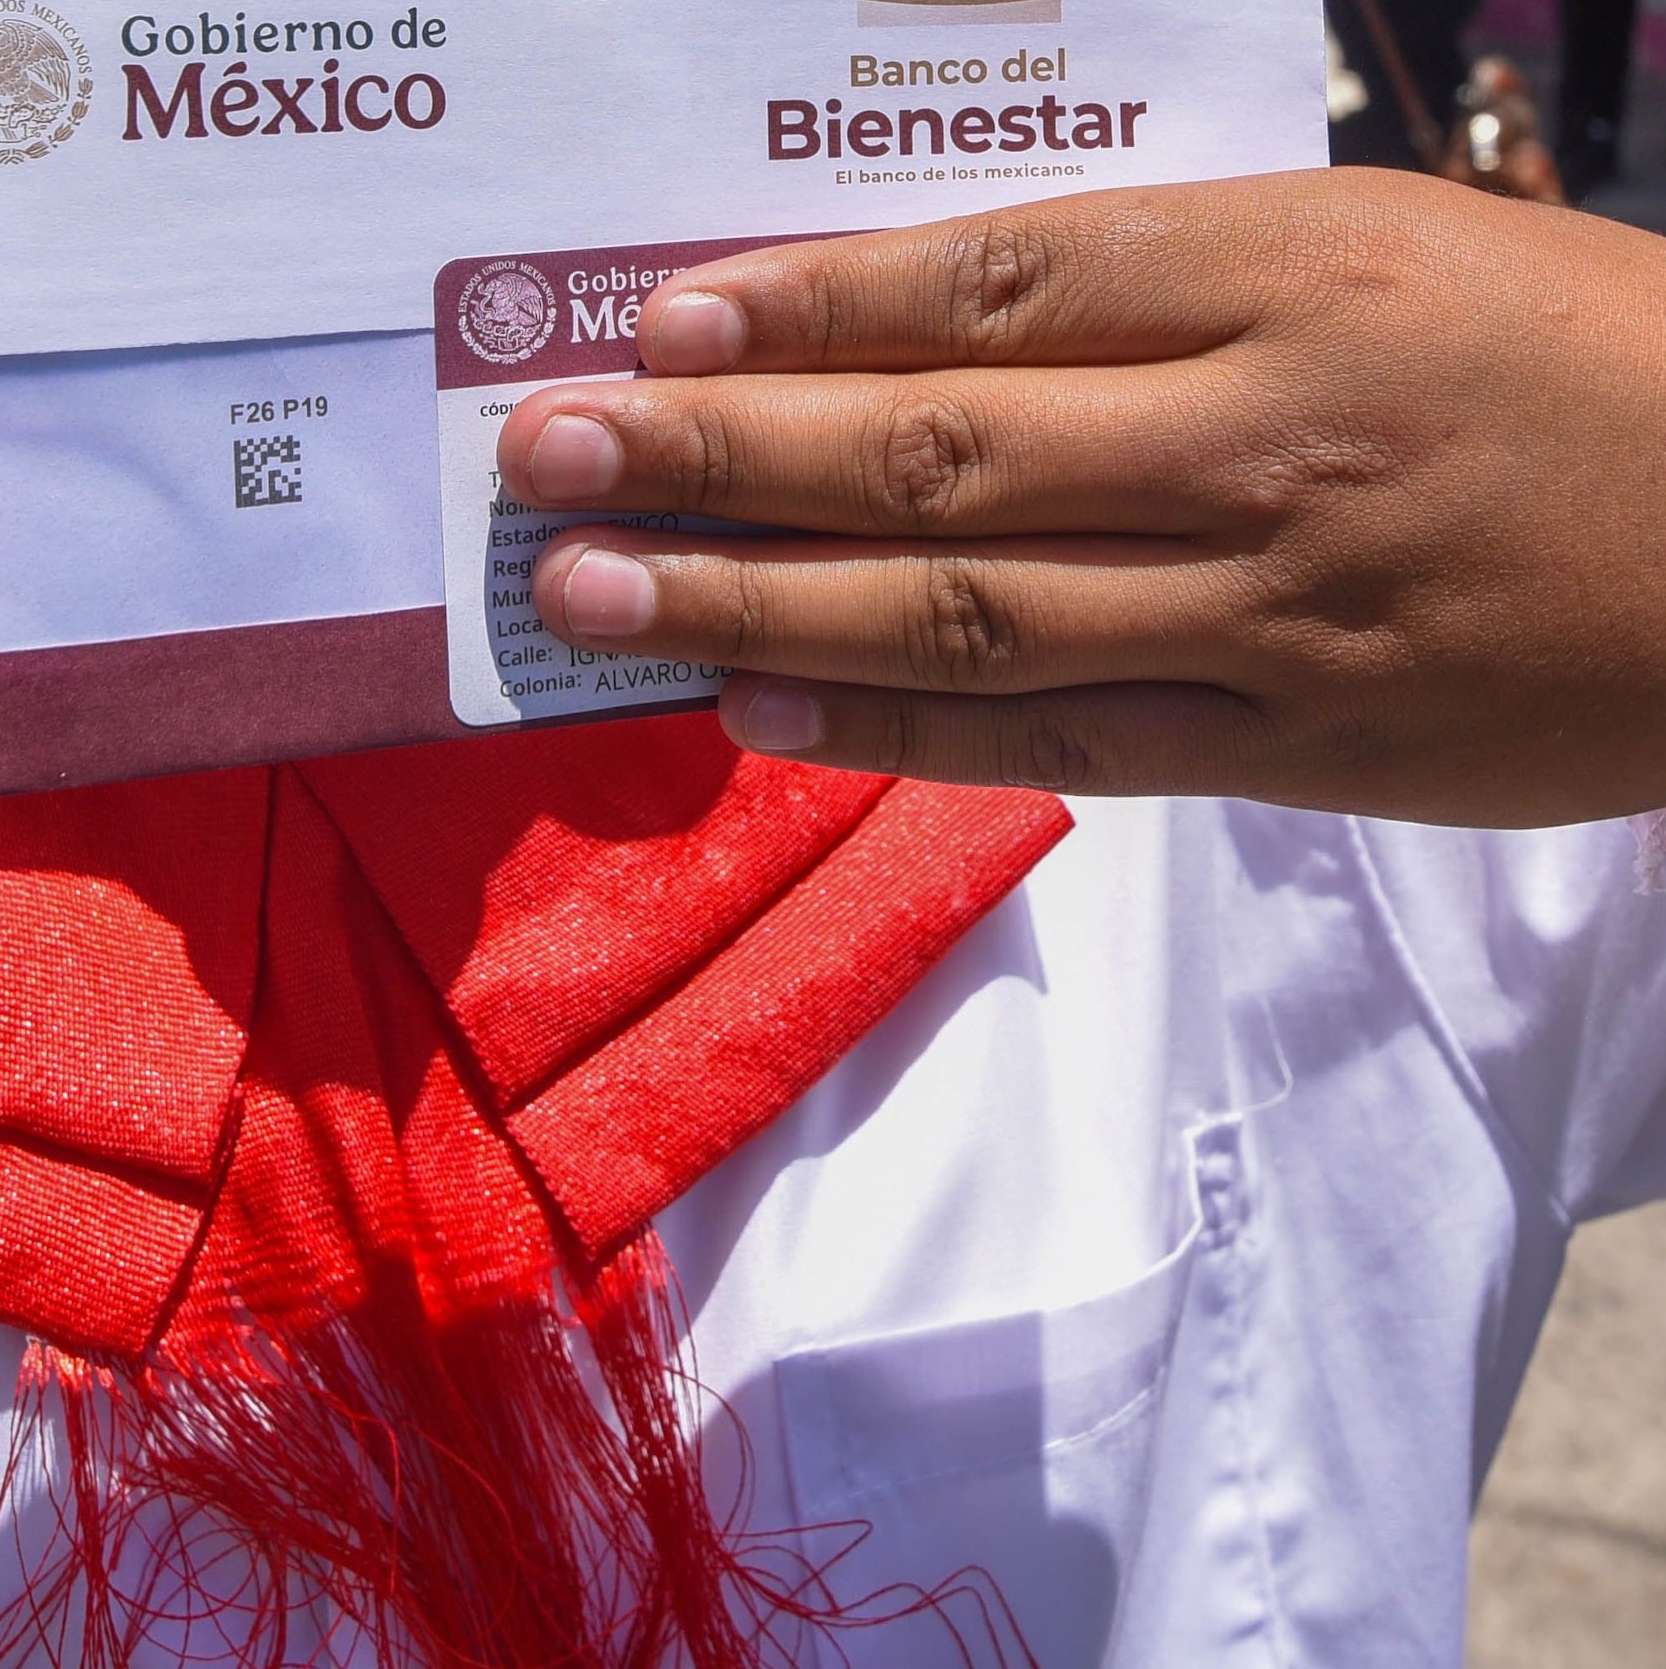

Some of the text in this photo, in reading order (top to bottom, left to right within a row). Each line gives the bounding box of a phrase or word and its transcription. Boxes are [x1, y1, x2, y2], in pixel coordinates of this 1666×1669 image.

[30, 3, 93, 75] MEXICANOS
[121, 6, 448, 58] Gobierno de
[849, 47, 1068, 88] Banco del
[120, 58, 448, 141] México
[766, 94, 1148, 162] Bienestar
[835, 162, 1085, 185] El banco de los mexicanos
[457, 260, 556, 313] ESTADOS UNIDOS MEXICANOS
[230, 395, 328, 425] F26 P19
[498, 646, 553, 668] Calle:
[500, 672, 583, 698] Colonia:
[595, 661, 692, 694] ALVARO
